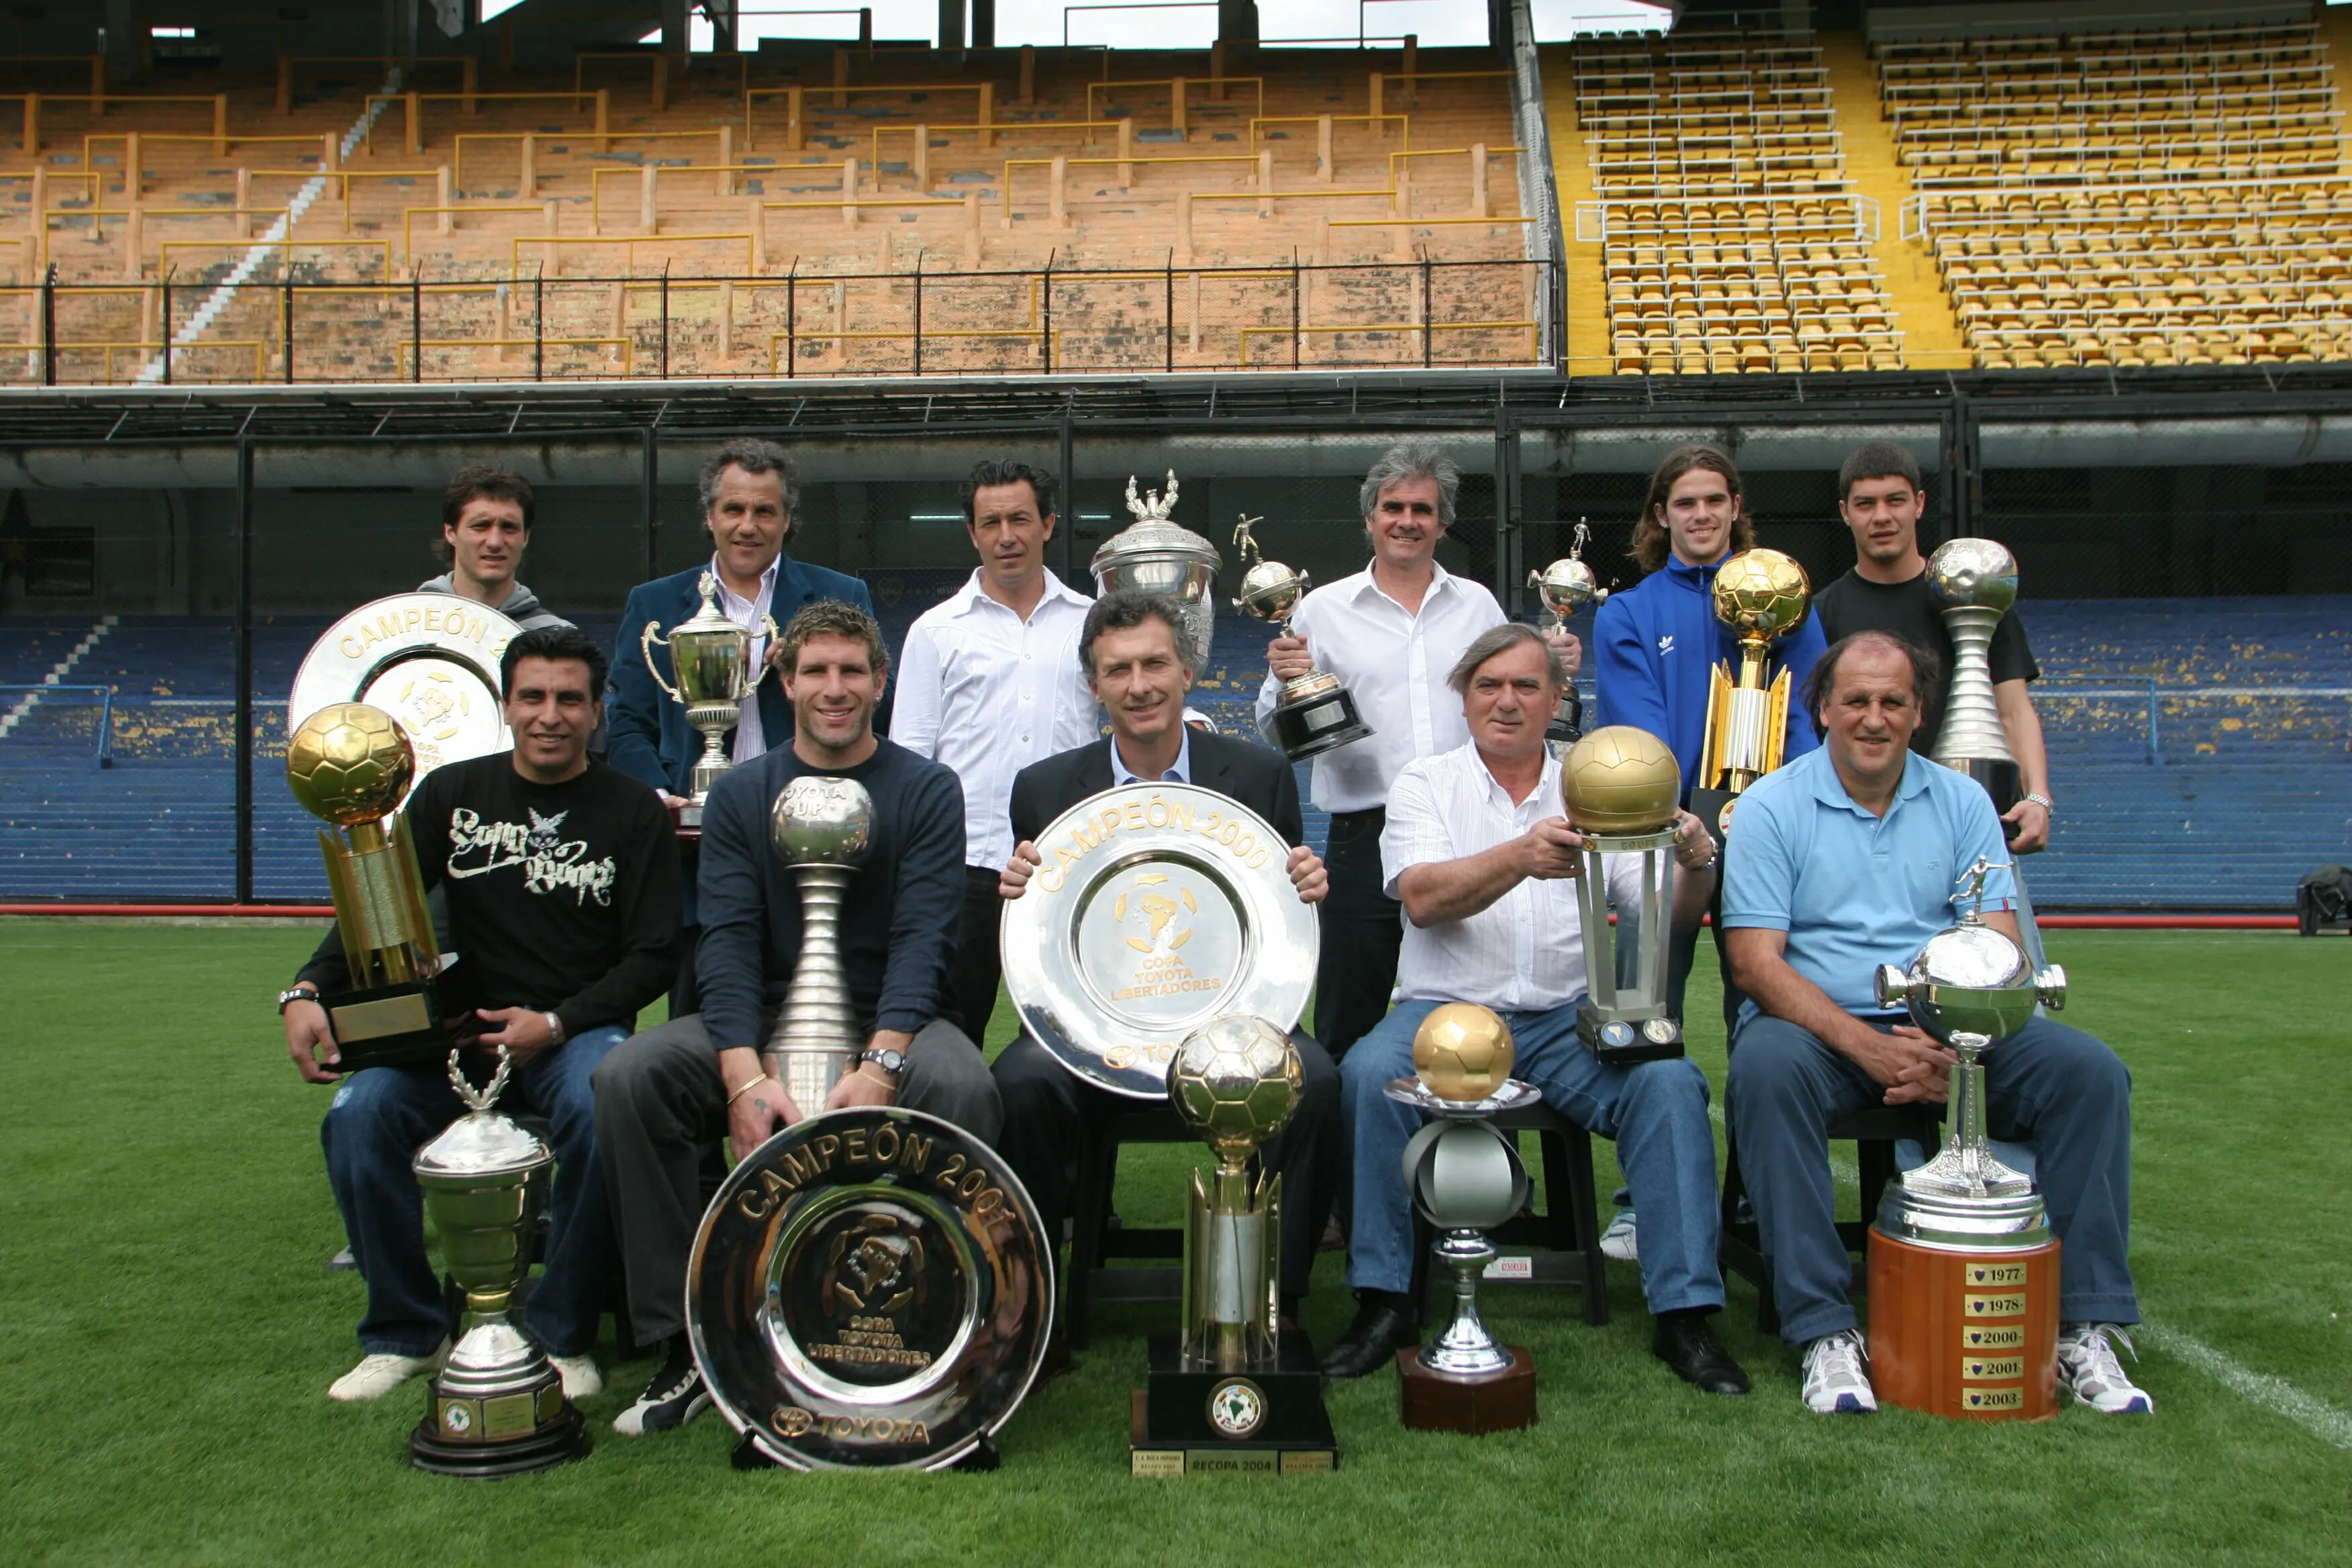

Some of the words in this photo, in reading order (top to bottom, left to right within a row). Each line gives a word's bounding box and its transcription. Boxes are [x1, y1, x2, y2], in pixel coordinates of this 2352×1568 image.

[339, 607, 489, 659] CAMPEÓN
[415, 752, 445, 766] YOTA
[783, 801, 824, 816] CUP
[1036, 793, 1195, 893] CAMPEÓN
[1201, 811, 1271, 869] 2000
[1142, 955, 1183, 971] COPA
[1134, 968, 1194, 984] TOYOTA
[1111, 978, 1222, 1001] LIBERTADORES
[738, 1122, 933, 1220] CAMPEÓN
[937, 1153, 1016, 1230] 2001
[1991, 1268, 2020, 1281] 1977
[1989, 1299, 2019, 1312] 1978
[849, 1315, 895, 1332] COPA
[838, 1330, 903, 1349] TOYOTA
[1983, 1331, 2017, 1344] 2000
[807, 1342, 931, 1367] LIBERTADORES
[1988, 1363, 2018, 1375] 2001
[1983, 1393, 2016, 1406] 2003
[818, 1416, 930, 1444] TOYOTA
[1192, 1460, 1238, 1471] RECOPA
[1242, 1461, 1271, 1471] 2004
